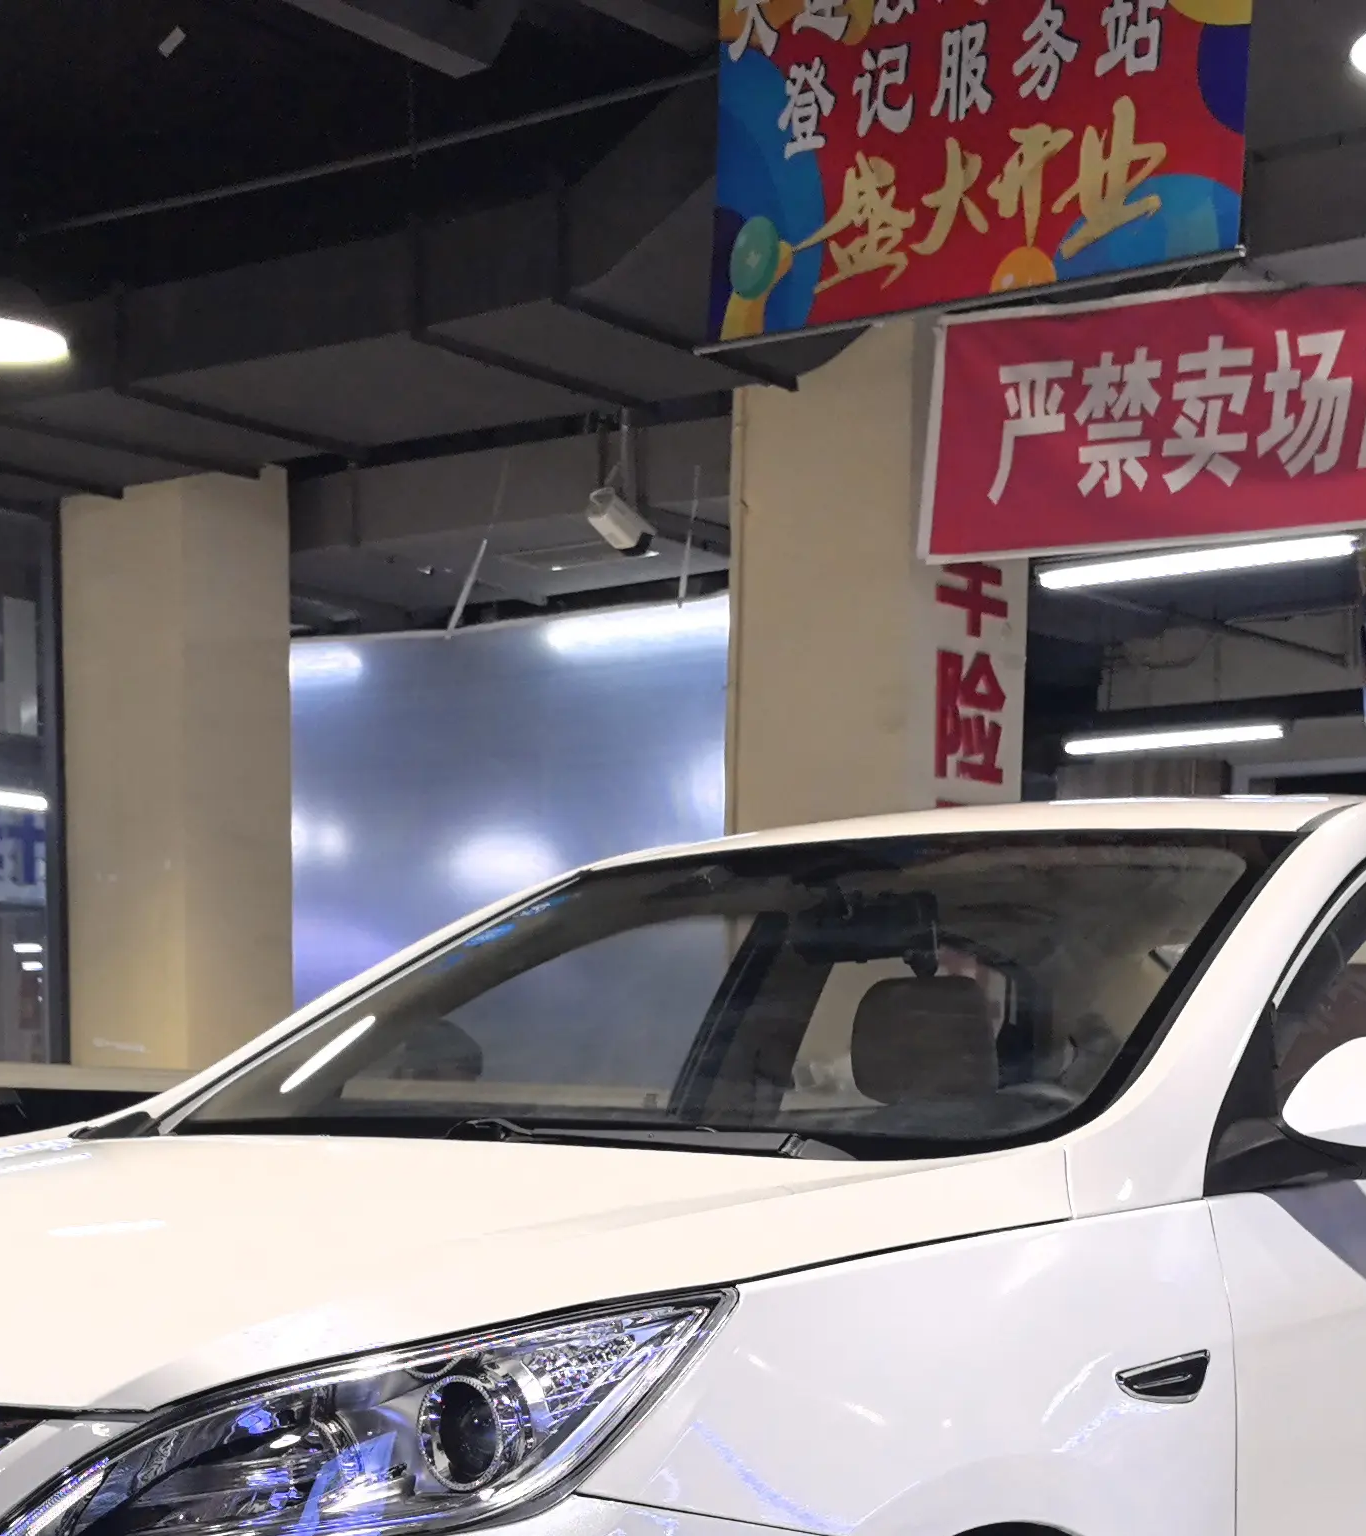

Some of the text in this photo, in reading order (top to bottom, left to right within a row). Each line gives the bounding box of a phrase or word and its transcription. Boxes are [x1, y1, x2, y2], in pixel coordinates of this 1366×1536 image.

[777, 0, 1167, 159] 登记服务站
[792, 95, 1167, 293] 盛大开业
